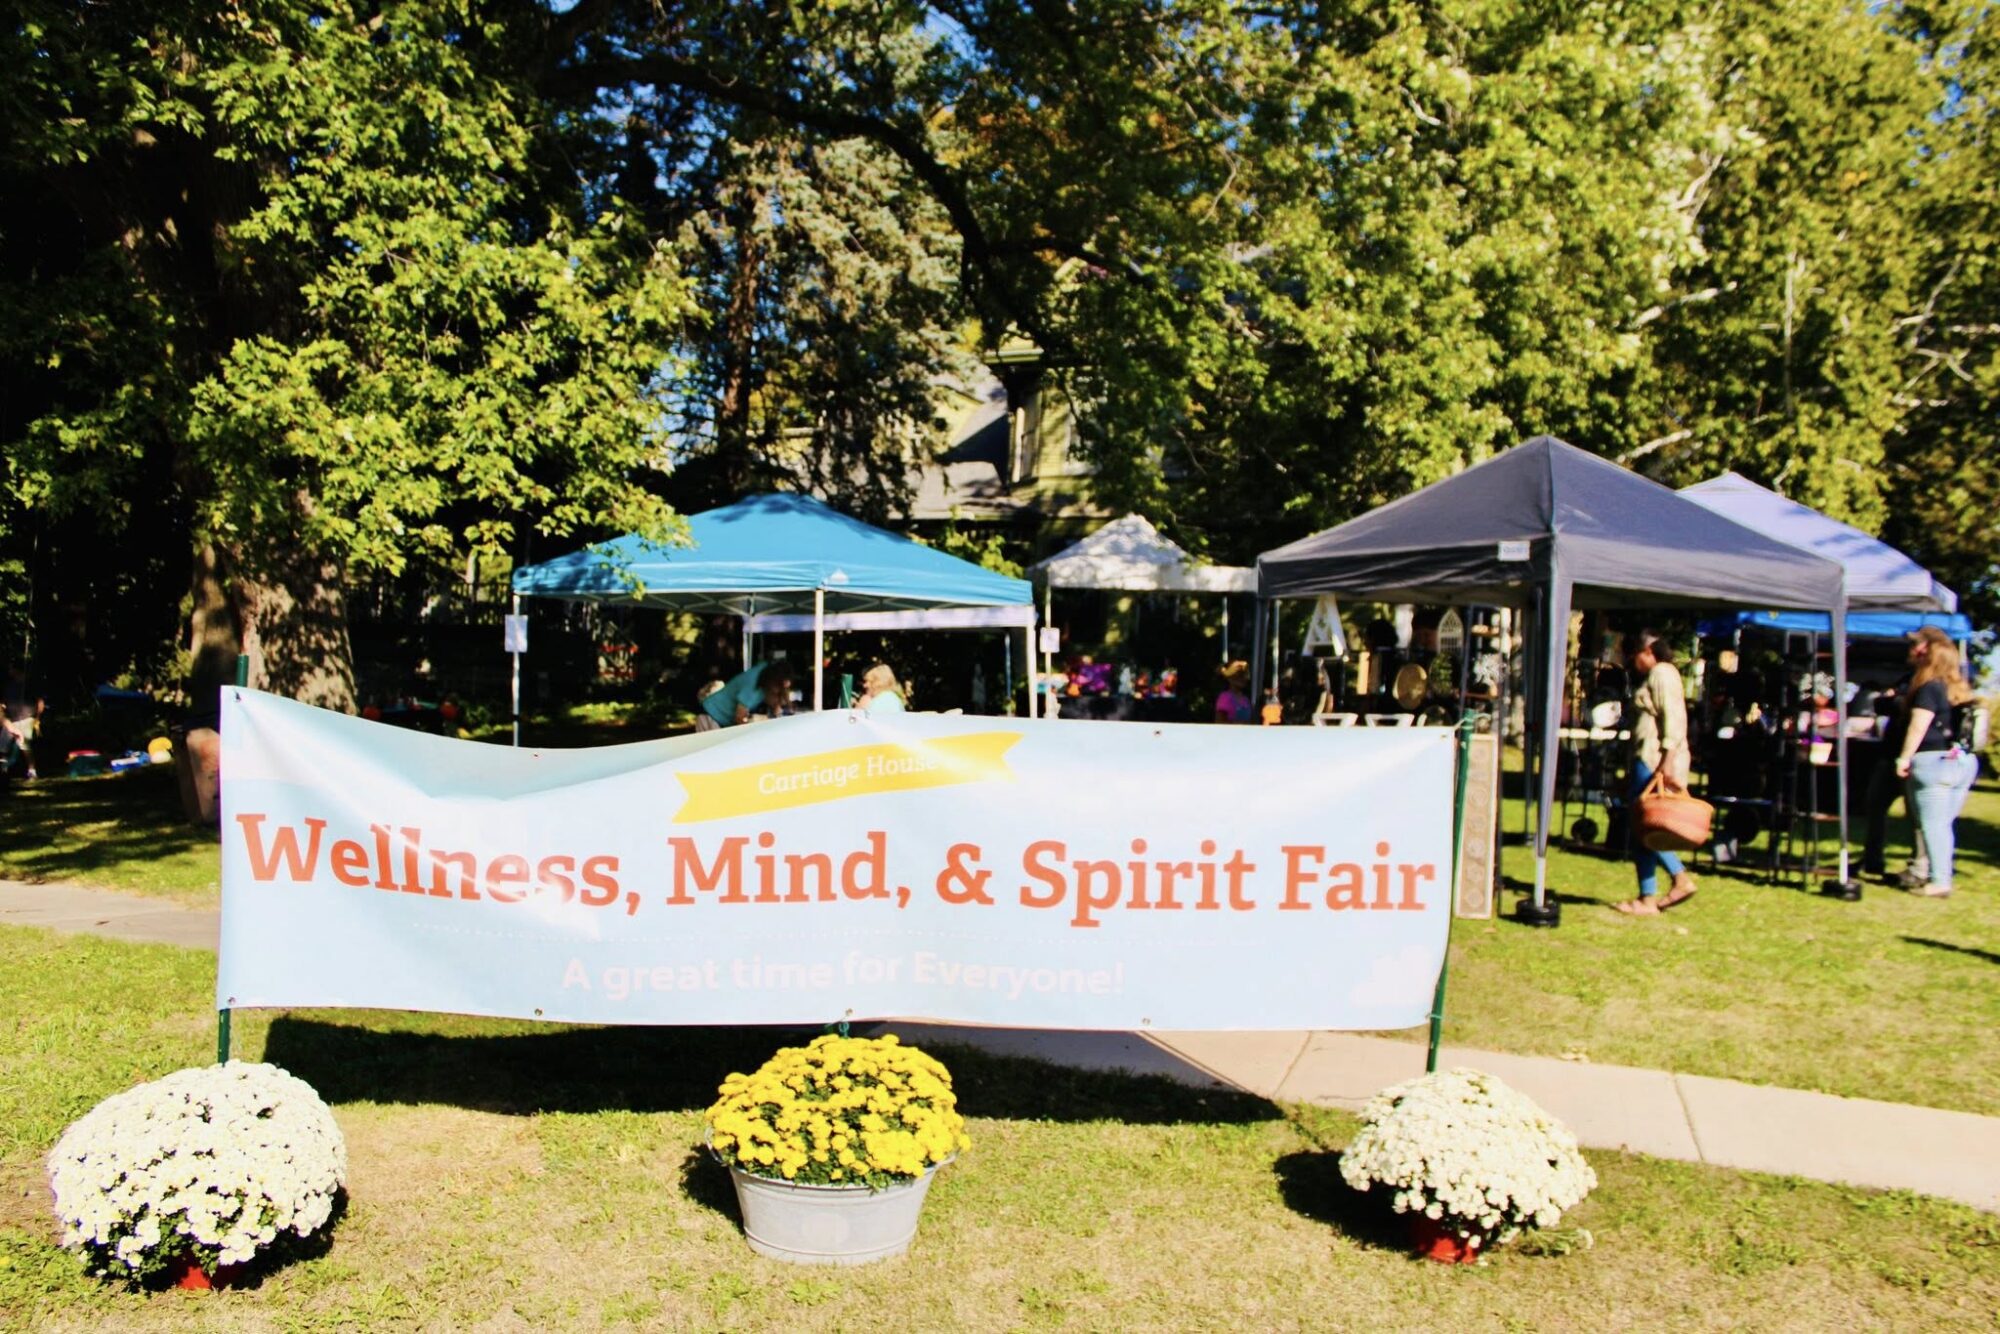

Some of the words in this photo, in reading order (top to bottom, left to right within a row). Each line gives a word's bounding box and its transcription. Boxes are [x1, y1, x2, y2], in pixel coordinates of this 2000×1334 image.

[758, 764, 859, 795] Carriage
[235, 813, 641, 916] Wellness,
[666, 830, 912, 909] Mind,
[935, 842, 995, 907] &
[1019, 838, 1257, 929] Spirit
[1278, 841, 1436, 912] Fair
[562, 957, 592, 991] A
[602, 957, 720, 1001] great
[730, 953, 834, 991] time
[842, 950, 903, 985] for
[912, 951, 1126, 1000] Everyone!
